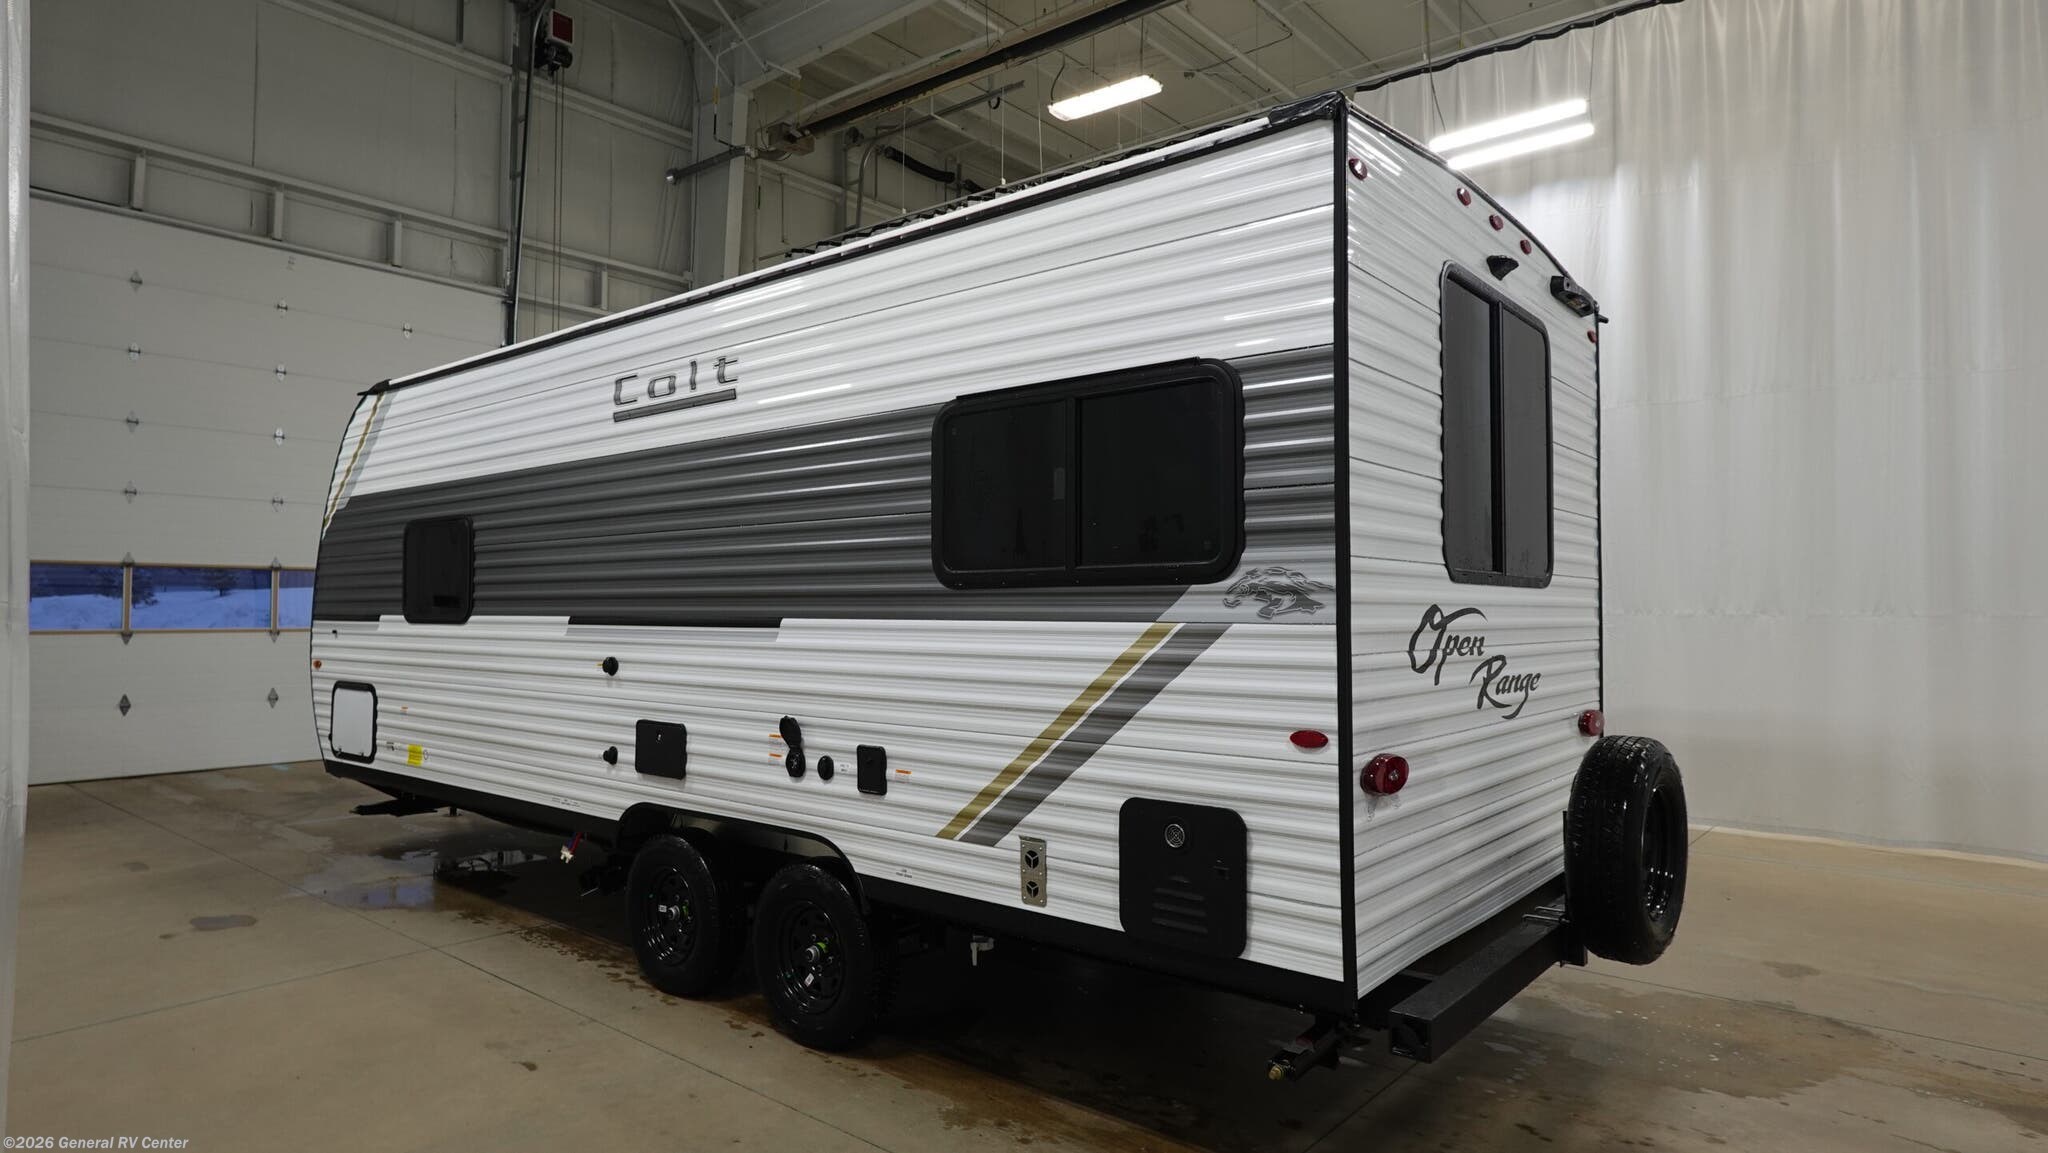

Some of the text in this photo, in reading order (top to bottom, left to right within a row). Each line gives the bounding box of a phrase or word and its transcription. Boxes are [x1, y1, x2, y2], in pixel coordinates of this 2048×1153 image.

[613, 355, 738, 406] Colt
[1408, 603, 1488, 686] Open
[1469, 654, 1541, 720] Range
